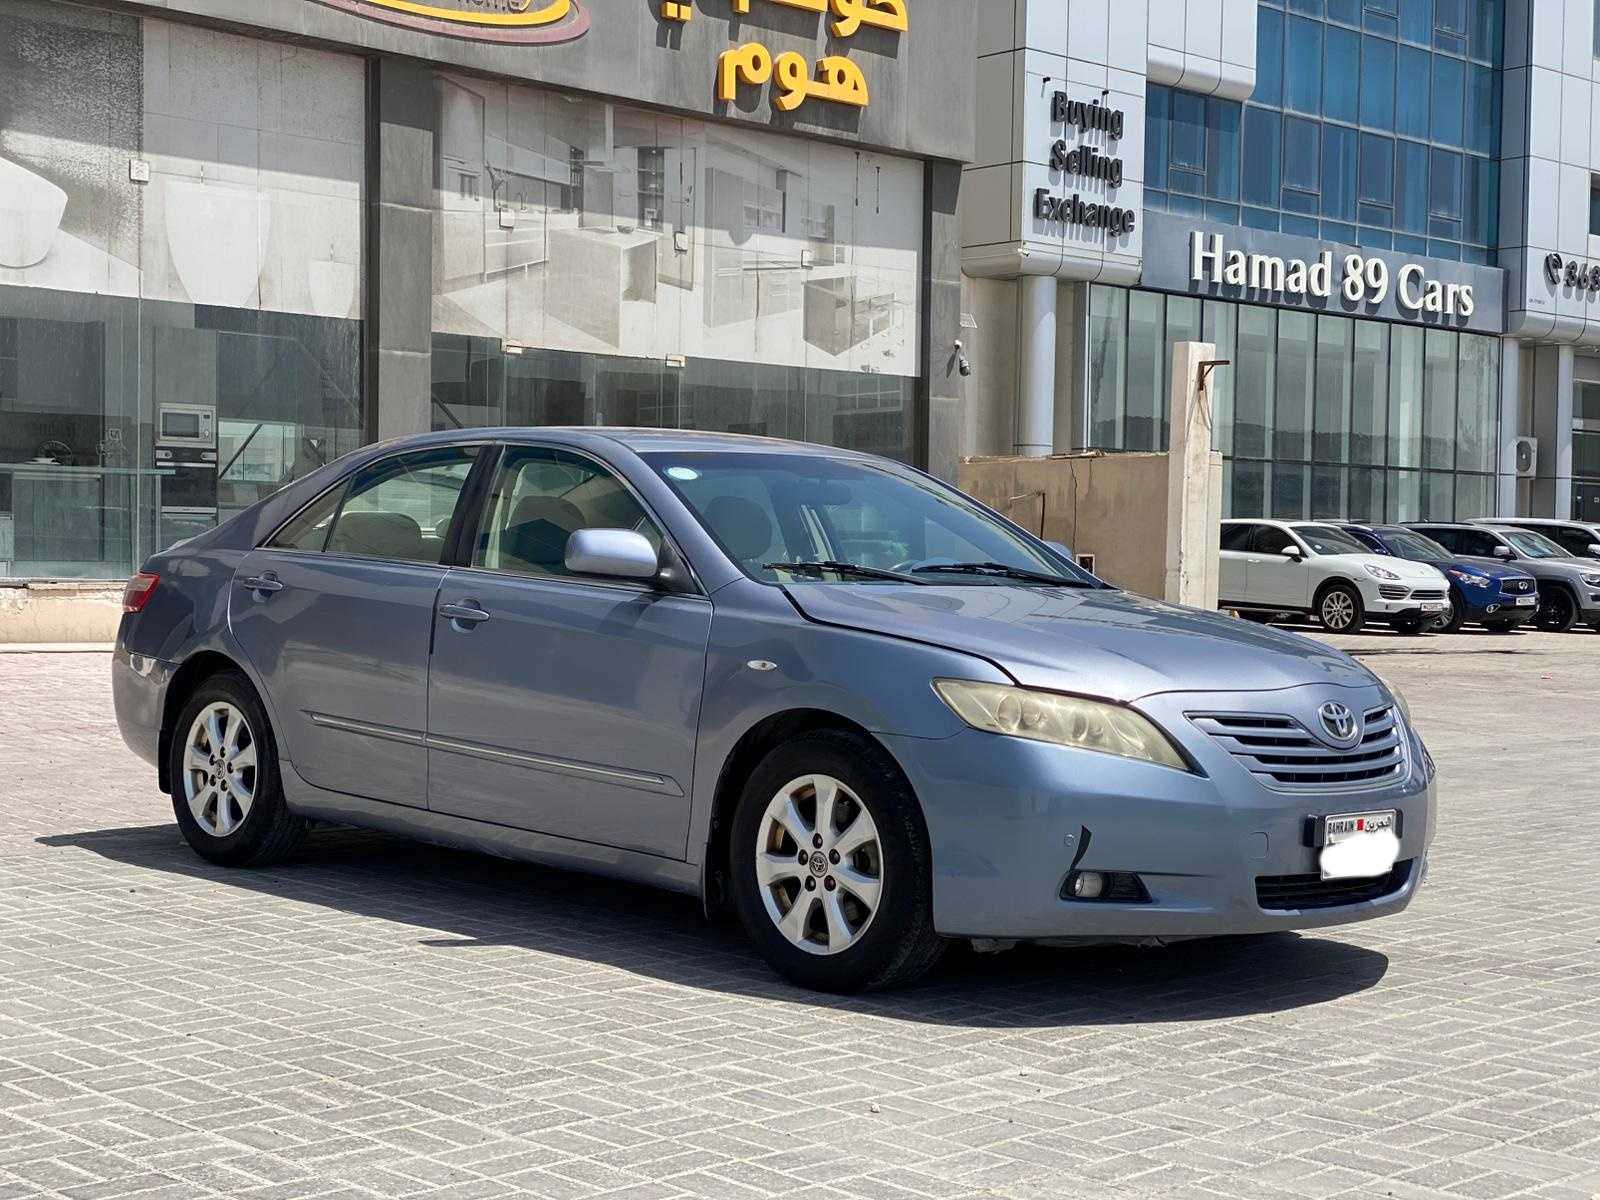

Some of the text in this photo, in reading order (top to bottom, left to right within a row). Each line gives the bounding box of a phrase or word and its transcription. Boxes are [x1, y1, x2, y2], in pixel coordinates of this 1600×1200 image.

[718, 42, 868, 111] هوم
[1051, 91, 1123, 141] Buying
[1049, 140, 1122, 188] Selling
[1033, 188, 1135, 237] Exchange
[1190, 231, 1474, 316] Hamad 89 Cars
[1328, 820, 1354, 834] BAHRAIN
